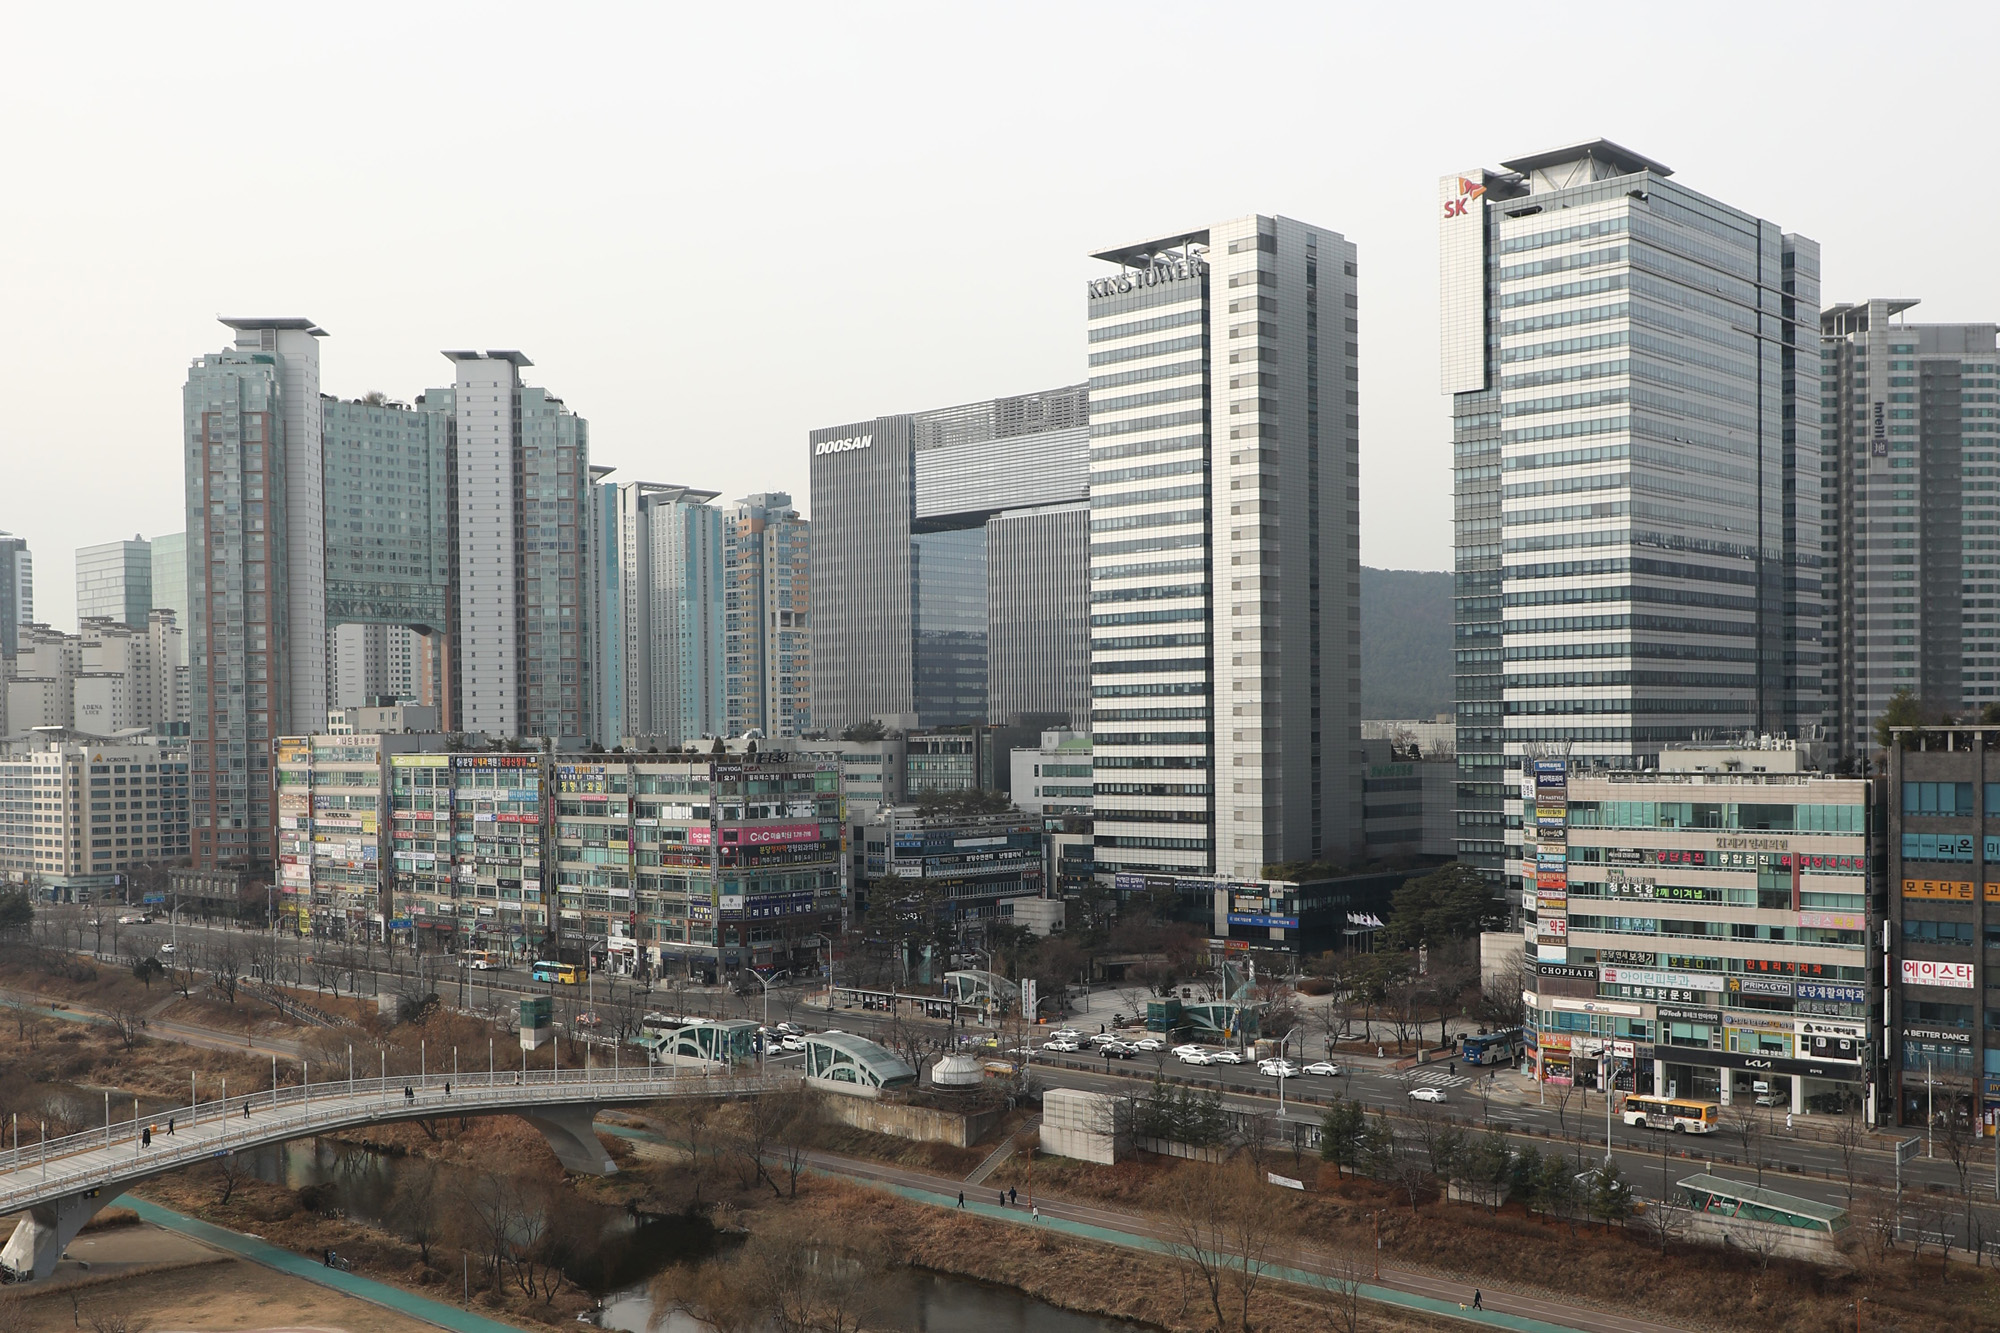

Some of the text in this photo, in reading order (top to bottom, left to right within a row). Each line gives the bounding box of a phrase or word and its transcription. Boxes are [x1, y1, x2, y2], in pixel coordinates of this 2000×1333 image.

[1444, 198, 1468, 218] SK
[1087, 257, 1203, 299] KINS TOWER
[815, 434, 872, 456] DOOSAN
[750, 831, 770, 842] C&C
[1938, 839, 1972, 855] 리온
[1904, 881, 1972, 898] 모두다른
[1549, 920, 1566, 935] 약국
[1620, 971, 1690, 988] 아이린피부과
[1903, 961, 1973, 982] 에이스타
[1744, 981, 1789, 992] PRIMA GYM
[1797, 985, 1865, 1002] 분당재활의학과
[1910, 1030, 1941, 1040] BETTER
[1941, 1032, 1971, 1042] DANCE
[1745, 1059, 1772, 1069] KIA
